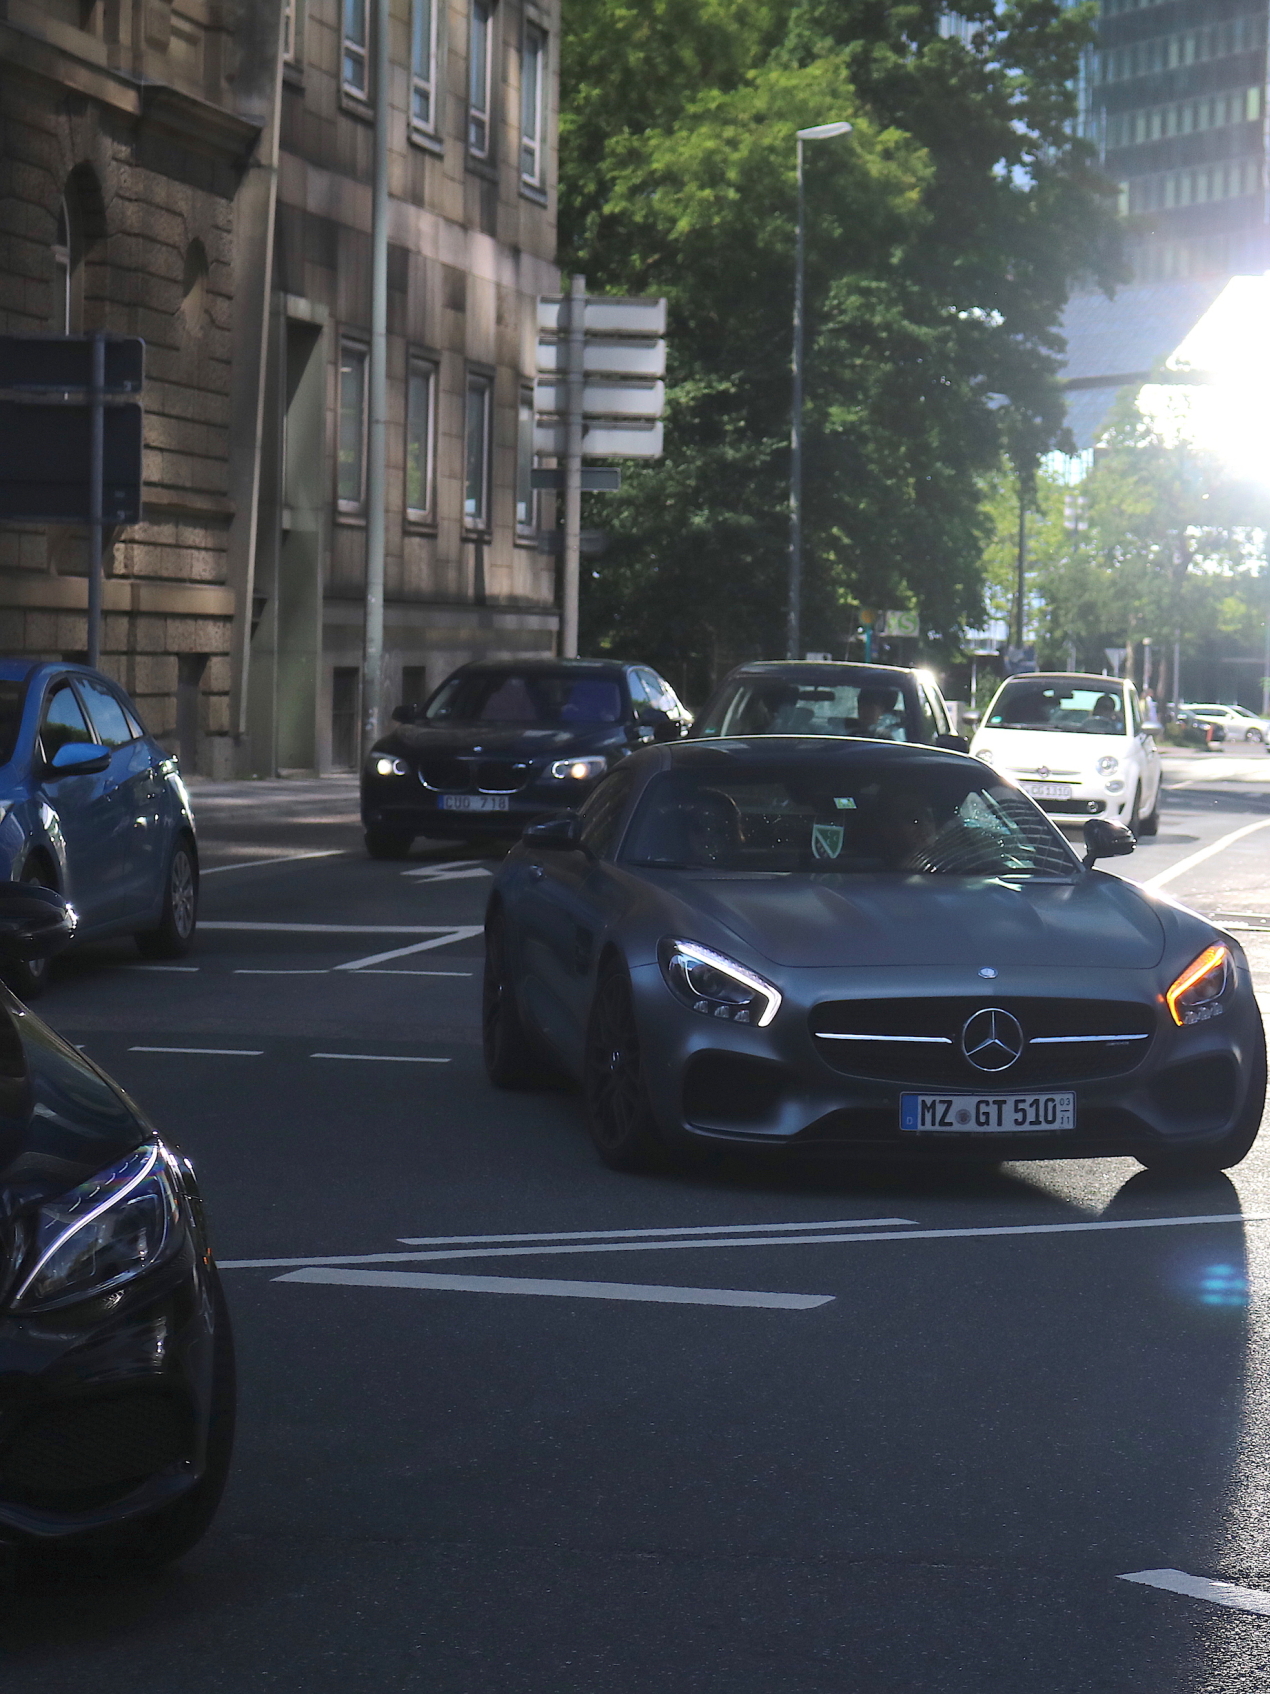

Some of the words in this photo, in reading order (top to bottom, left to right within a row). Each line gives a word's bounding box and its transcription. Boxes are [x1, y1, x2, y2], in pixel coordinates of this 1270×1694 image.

[921, 1099, 954, 1126] MZ
[975, 1099, 1007, 1126] GT
[1014, 1097, 1057, 1126] 510
